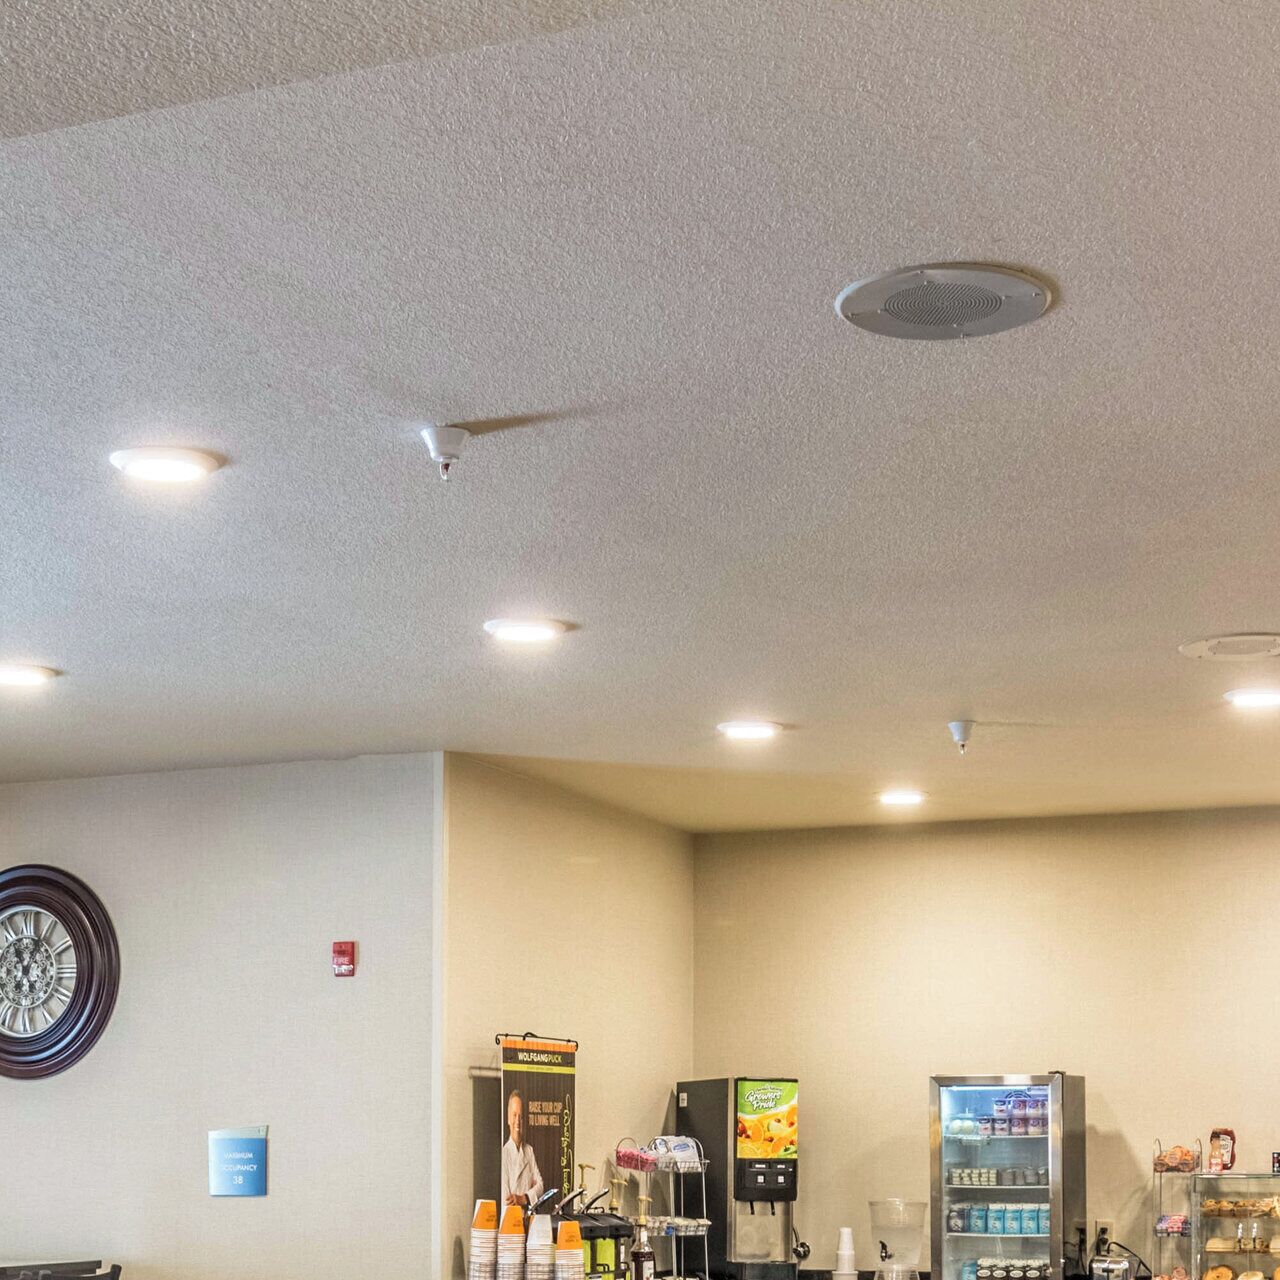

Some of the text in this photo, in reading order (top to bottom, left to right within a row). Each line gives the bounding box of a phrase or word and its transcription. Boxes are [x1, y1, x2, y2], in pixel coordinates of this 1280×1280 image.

[542, 1101, 553, 1113] YOUR
[554, 1102, 562, 1113] CUP
[528, 1114, 560, 1126] TO LIVING WELL
[232, 1175, 243, 1184] 38
